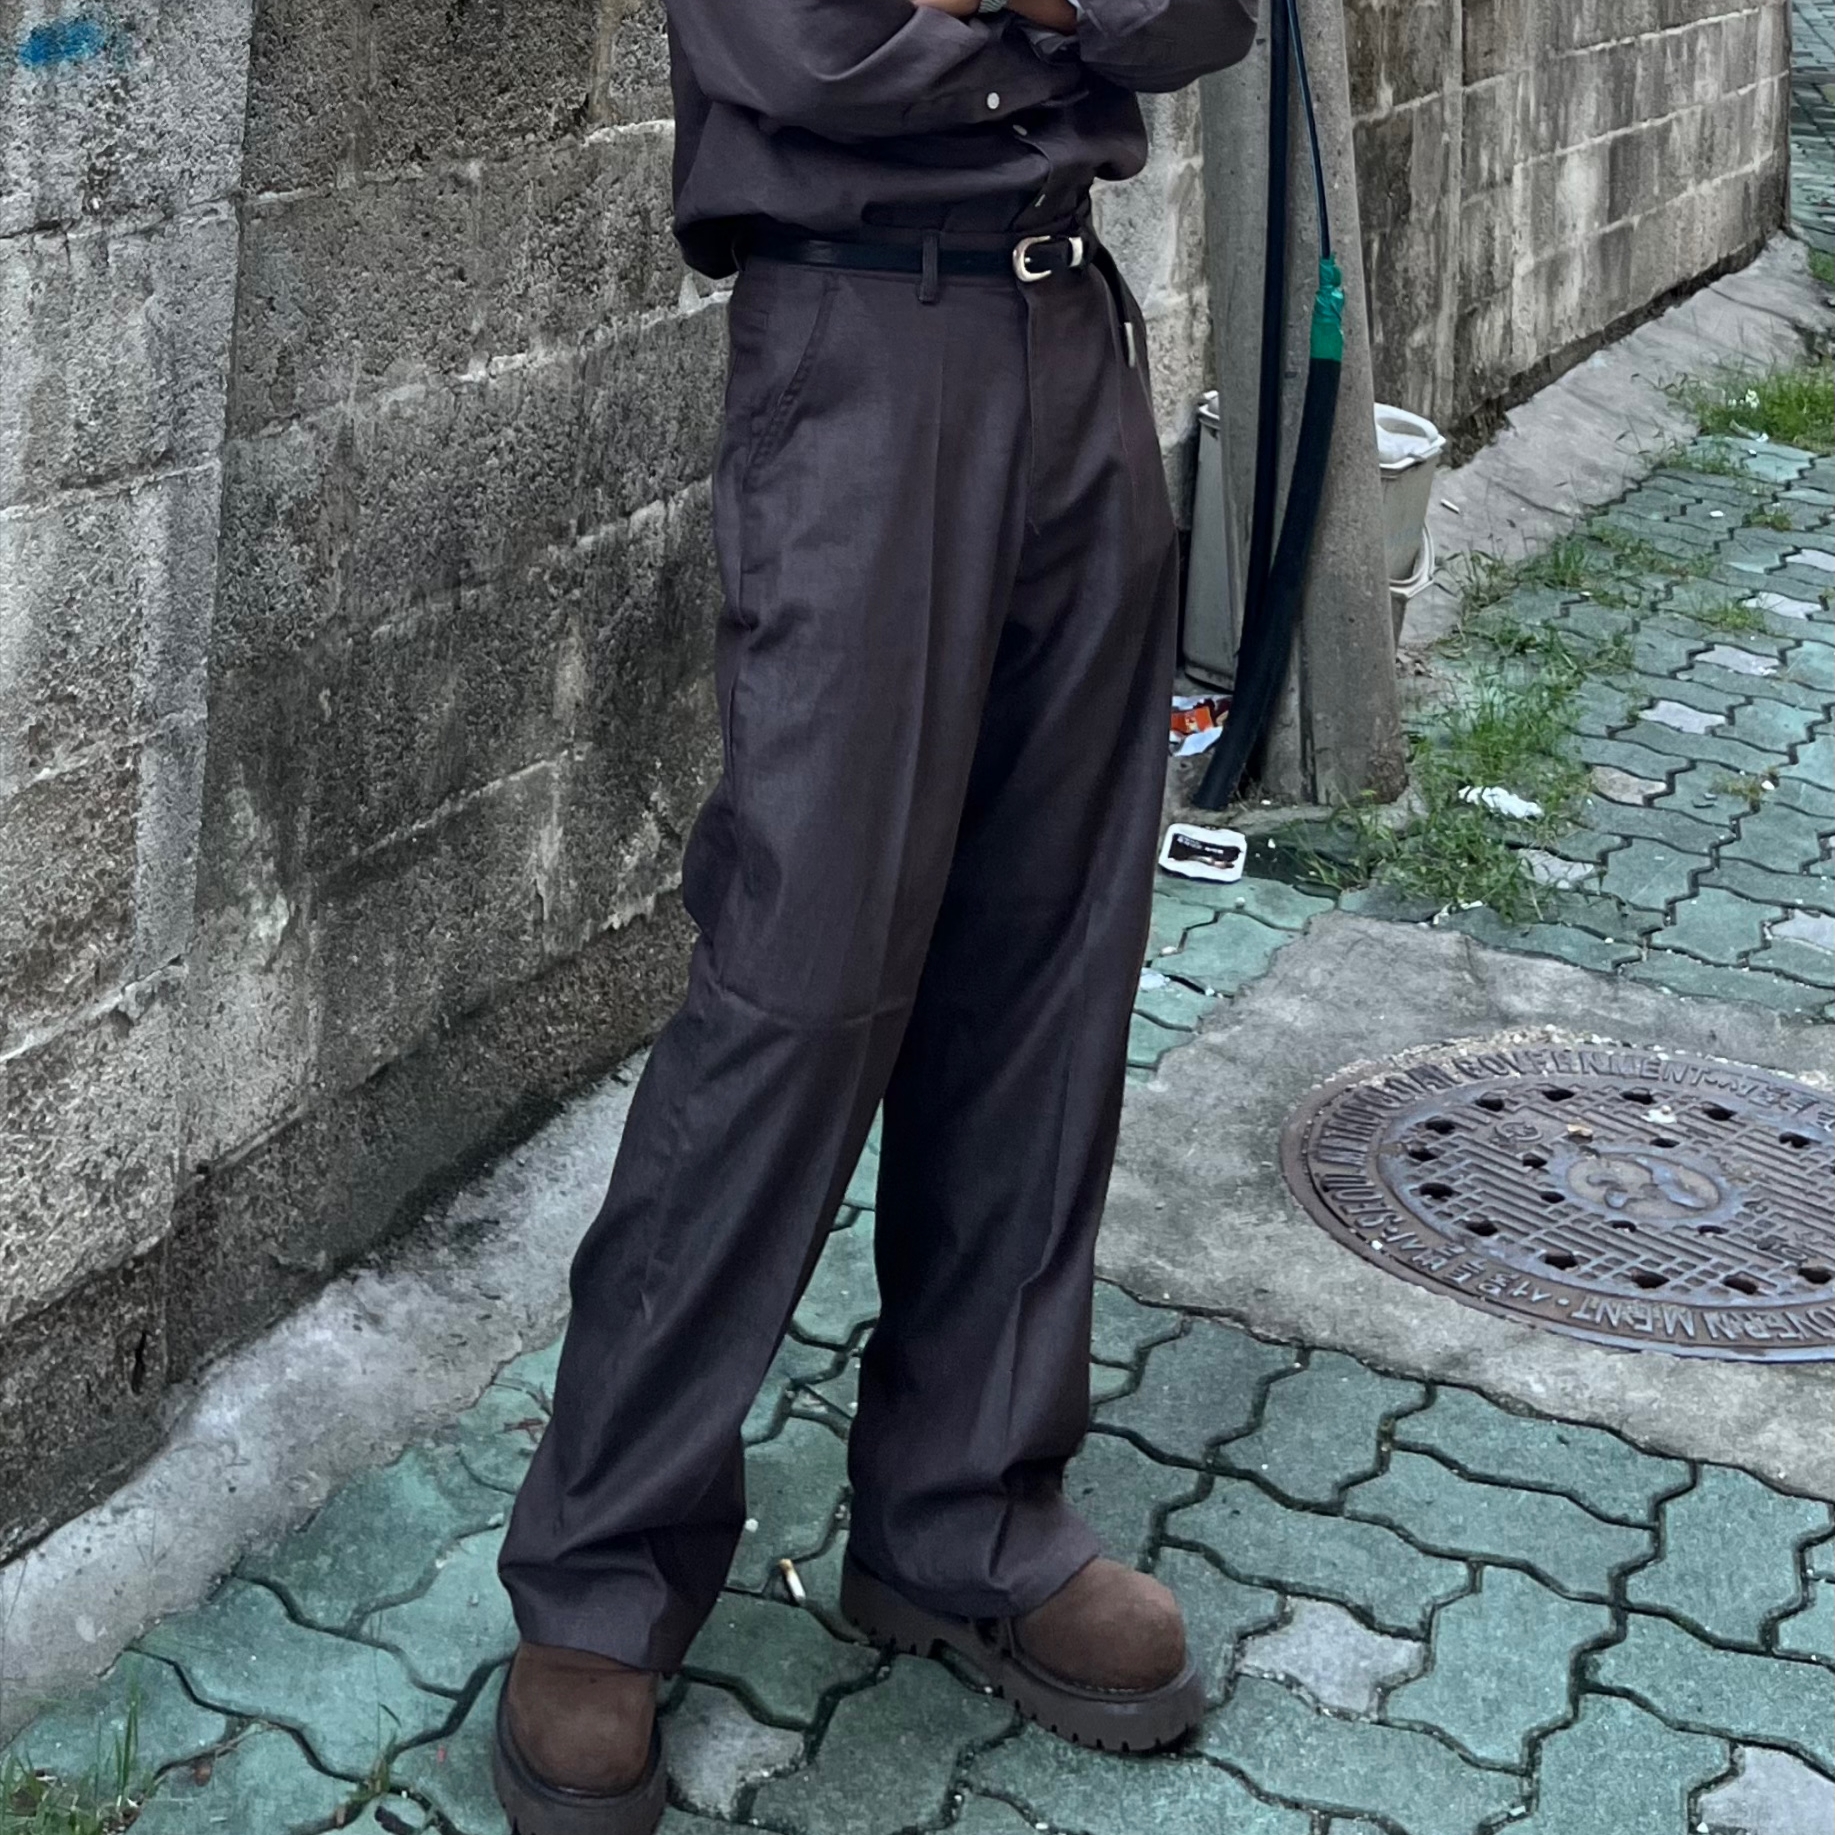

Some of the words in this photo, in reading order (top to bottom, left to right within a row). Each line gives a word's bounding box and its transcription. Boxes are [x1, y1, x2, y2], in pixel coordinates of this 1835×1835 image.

[1320, 1165, 1403, 1228] SEOUL
[1450, 1049, 1711, 1087] GOVERNMENT
[1571, 1294, 1835, 1341] OVERNMENT
